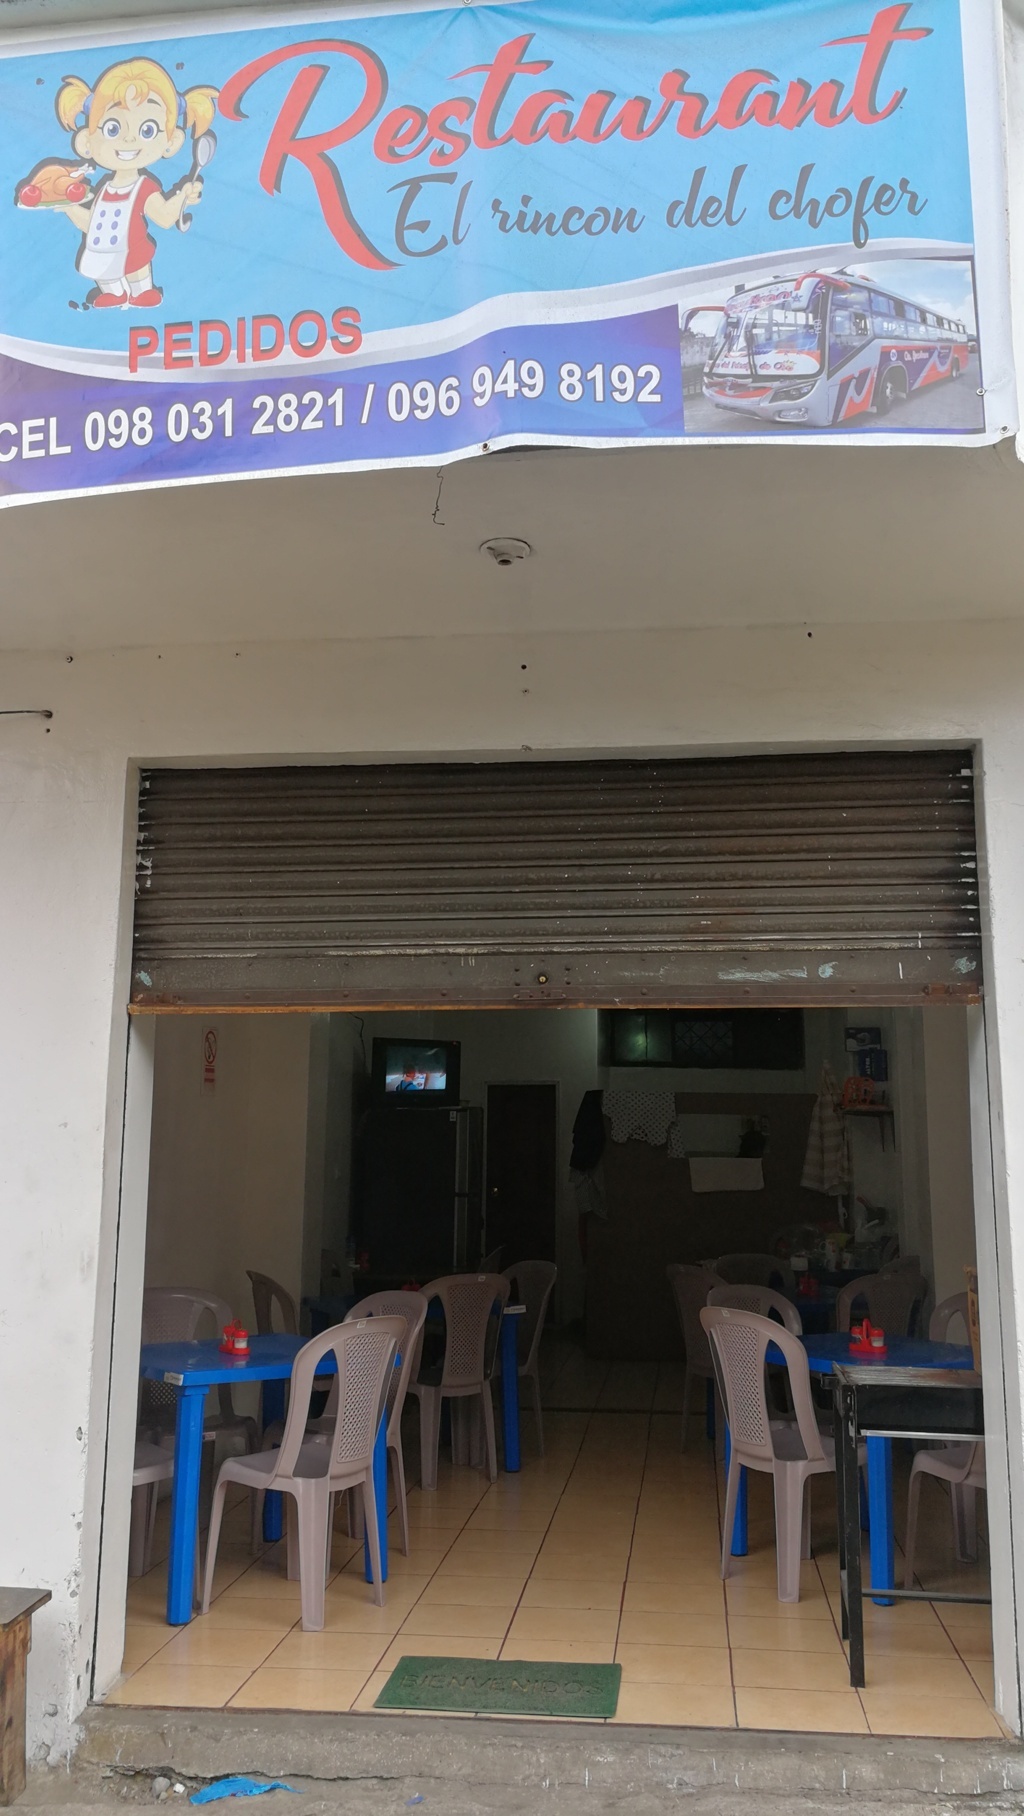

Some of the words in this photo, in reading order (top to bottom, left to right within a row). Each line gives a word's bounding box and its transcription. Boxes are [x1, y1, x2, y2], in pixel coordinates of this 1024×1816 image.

[217, 3, 934, 271] Restaurant
[386, 172, 475, 258] El
[492, 195, 646, 237] rincon
[666, 163, 748, 229] del
[768, 163, 928, 249] chofer
[129, 307, 363, 373] PEDIDOS
[0, 416, 72, 463] CEL
[84, 406, 154, 452] 098
[167, 398, 234, 444] 031
[251, 388, 345, 436] 2821
[386, 378, 461, 423] 096
[472, 359, 545, 408] 949
[558, 362, 663, 404] 8192
[400, 1673, 604, 1696] BIENVENIDOS
